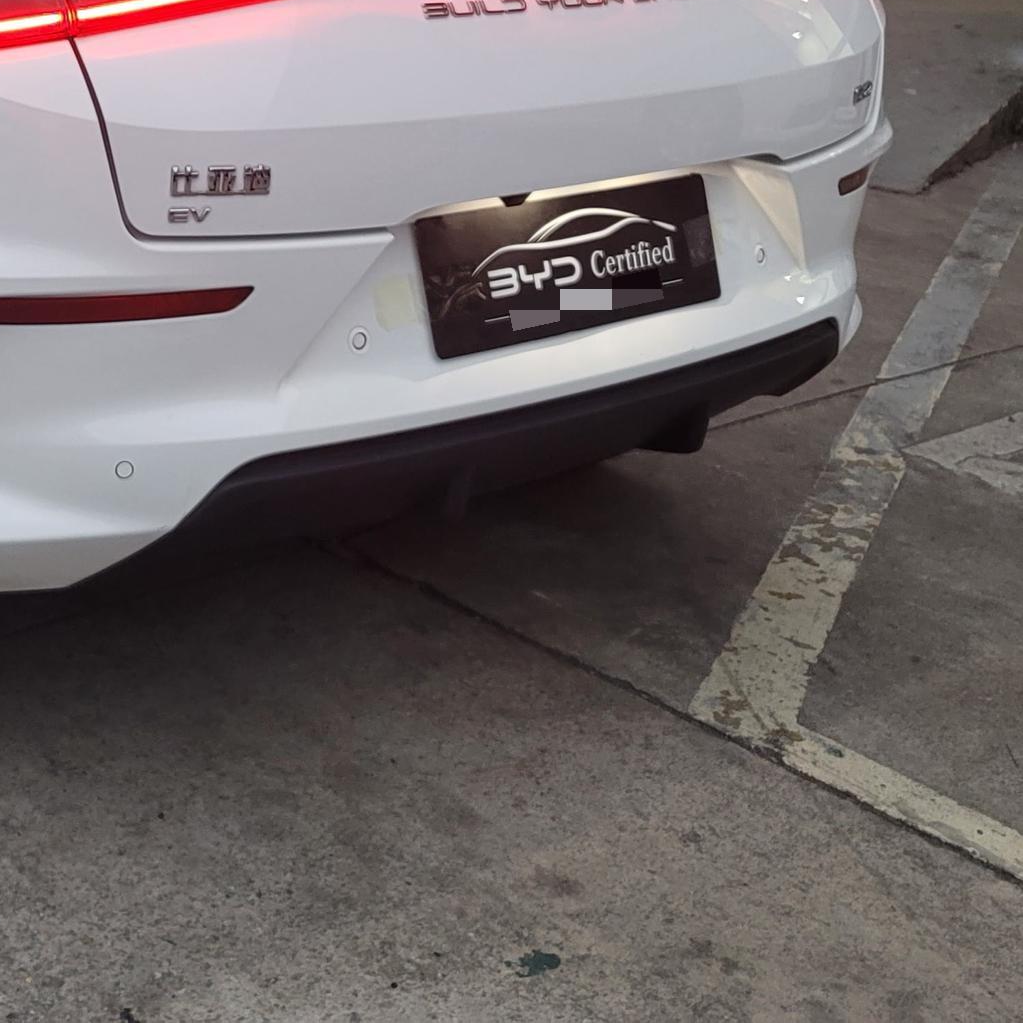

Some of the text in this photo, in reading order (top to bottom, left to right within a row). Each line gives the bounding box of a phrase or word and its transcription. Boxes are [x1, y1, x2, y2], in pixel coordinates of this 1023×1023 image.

[170, 164, 271, 197] 比亚迪
[168, 207, 211, 223] EV
[486, 236, 676, 300] BYD Certified
